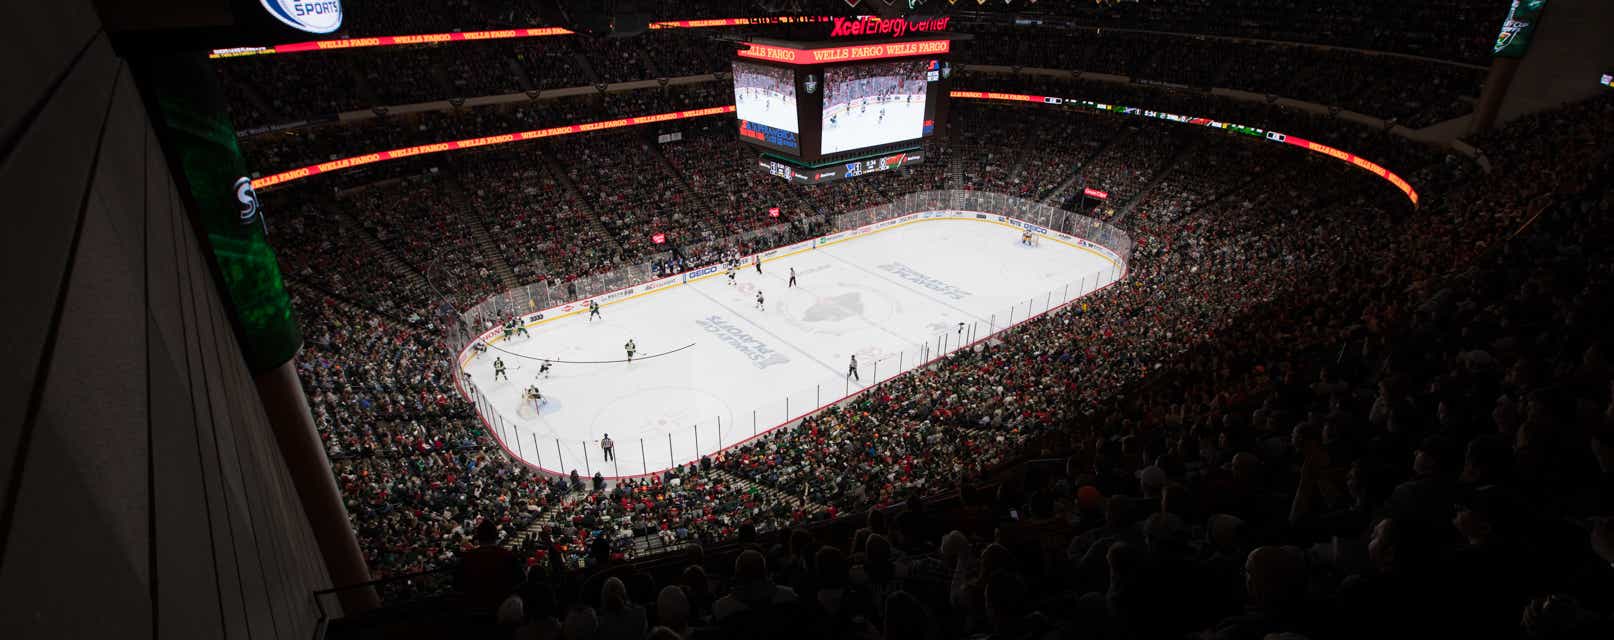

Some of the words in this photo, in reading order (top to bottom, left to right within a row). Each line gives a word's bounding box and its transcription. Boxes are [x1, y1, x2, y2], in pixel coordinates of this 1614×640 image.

[294, 1, 338, 16] SPORTS
[831, 16, 867, 37] Xcel
[866, 16, 907, 37] Energy
[394, 35, 422, 44] WELLS
[423, 33, 450, 42] FARGO
[464, 31, 489, 39] WELLS
[490, 30, 515, 39] FARGO
[318, 40, 348, 49] WELLS
[350, 38, 379, 47] FARGO
[886, 44, 917, 55] WELLS
[919, 41, 947, 52] FARGO
[768, 48, 794, 60] FARGO
[814, 49, 848, 60] WELLS
[851, 46, 883, 58] FARGO
[580, 123, 603, 132] WELLS
[605, 119, 627, 128] FARGO
[521, 129, 547, 139] WELLS
[548, 127, 572, 136] FARGO
[457, 138, 486, 148] WELLS
[487, 135, 513, 145] FARGO
[388, 147, 418, 158] WELLS
[420, 143, 448, 154] FARGO
[319, 160, 349, 172] WELLS
[351, 153, 379, 166] FARGO
[280, 168, 309, 182] FARGO
[1023, 223, 1047, 235] GEICO
[689, 266, 718, 279] GEICO
